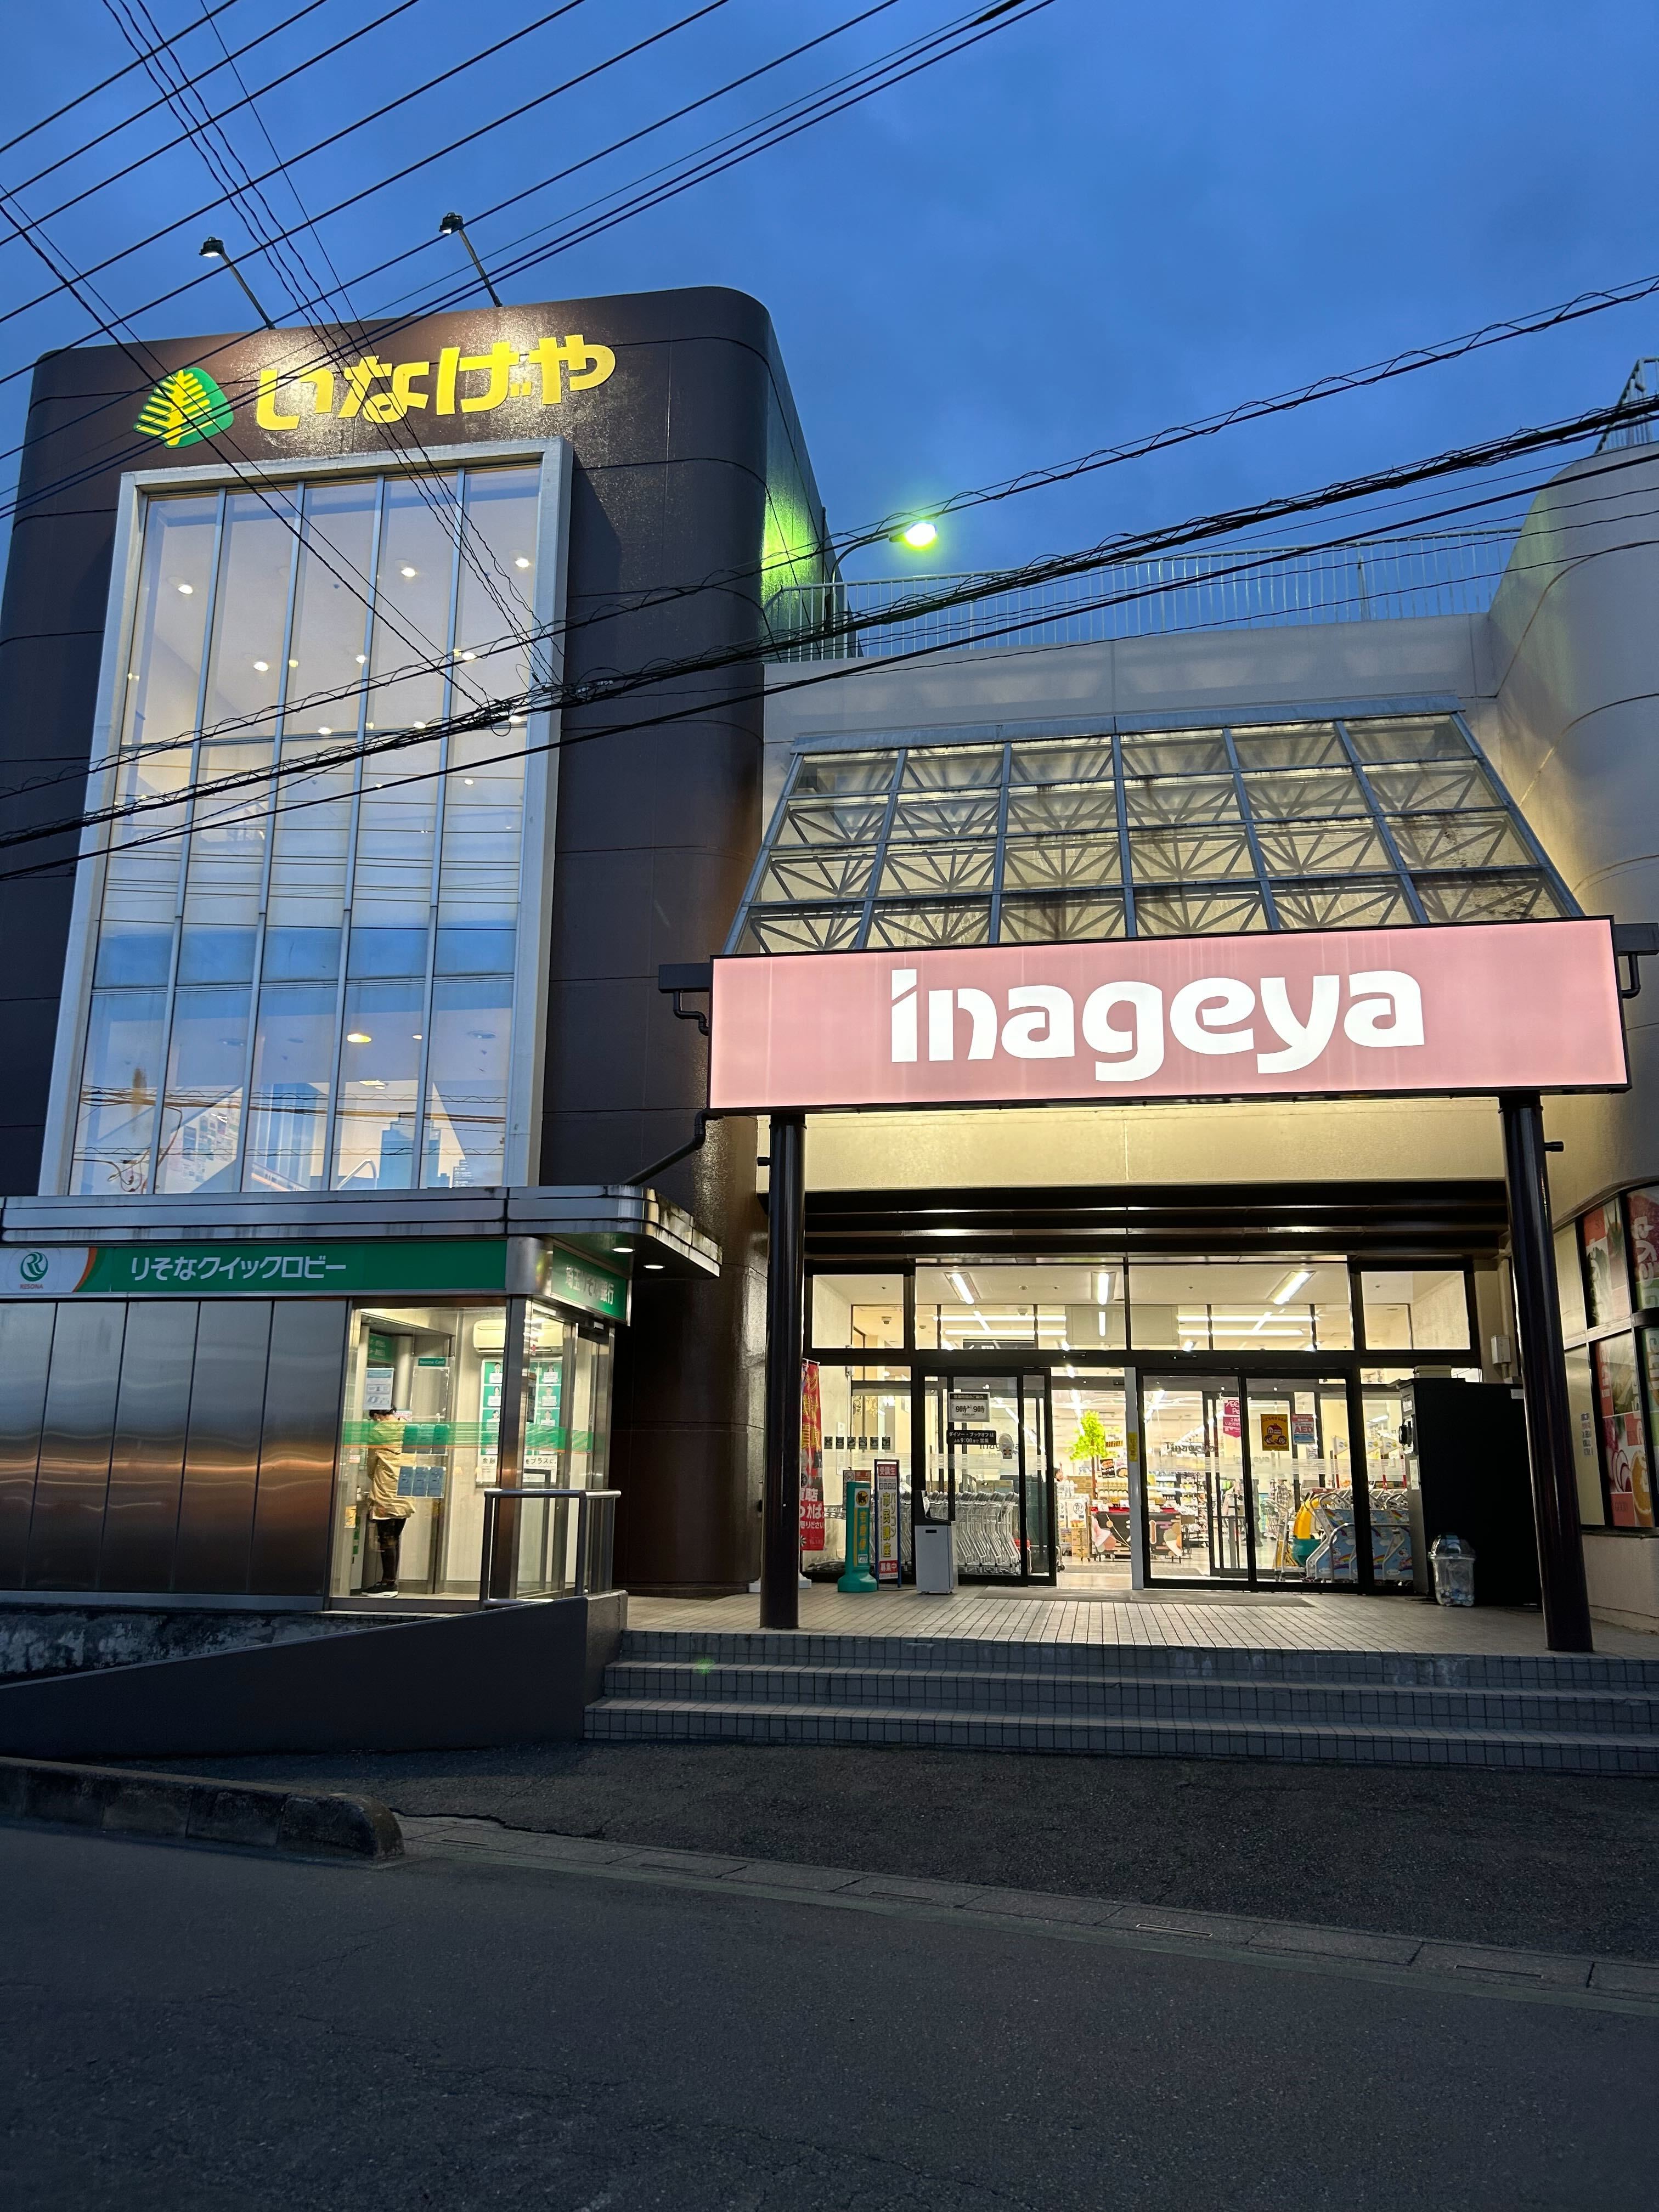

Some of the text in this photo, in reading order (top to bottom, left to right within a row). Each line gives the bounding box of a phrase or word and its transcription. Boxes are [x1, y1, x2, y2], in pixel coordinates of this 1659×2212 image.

[255, 334, 617, 431] いなげや
[891, 968, 1425, 1082] inageya
[131, 1255, 347, 1281] りそなクイックロビー
[882, 1492, 891, 1558] 市民講座
[880, 1562, 898, 1572] 募集中
